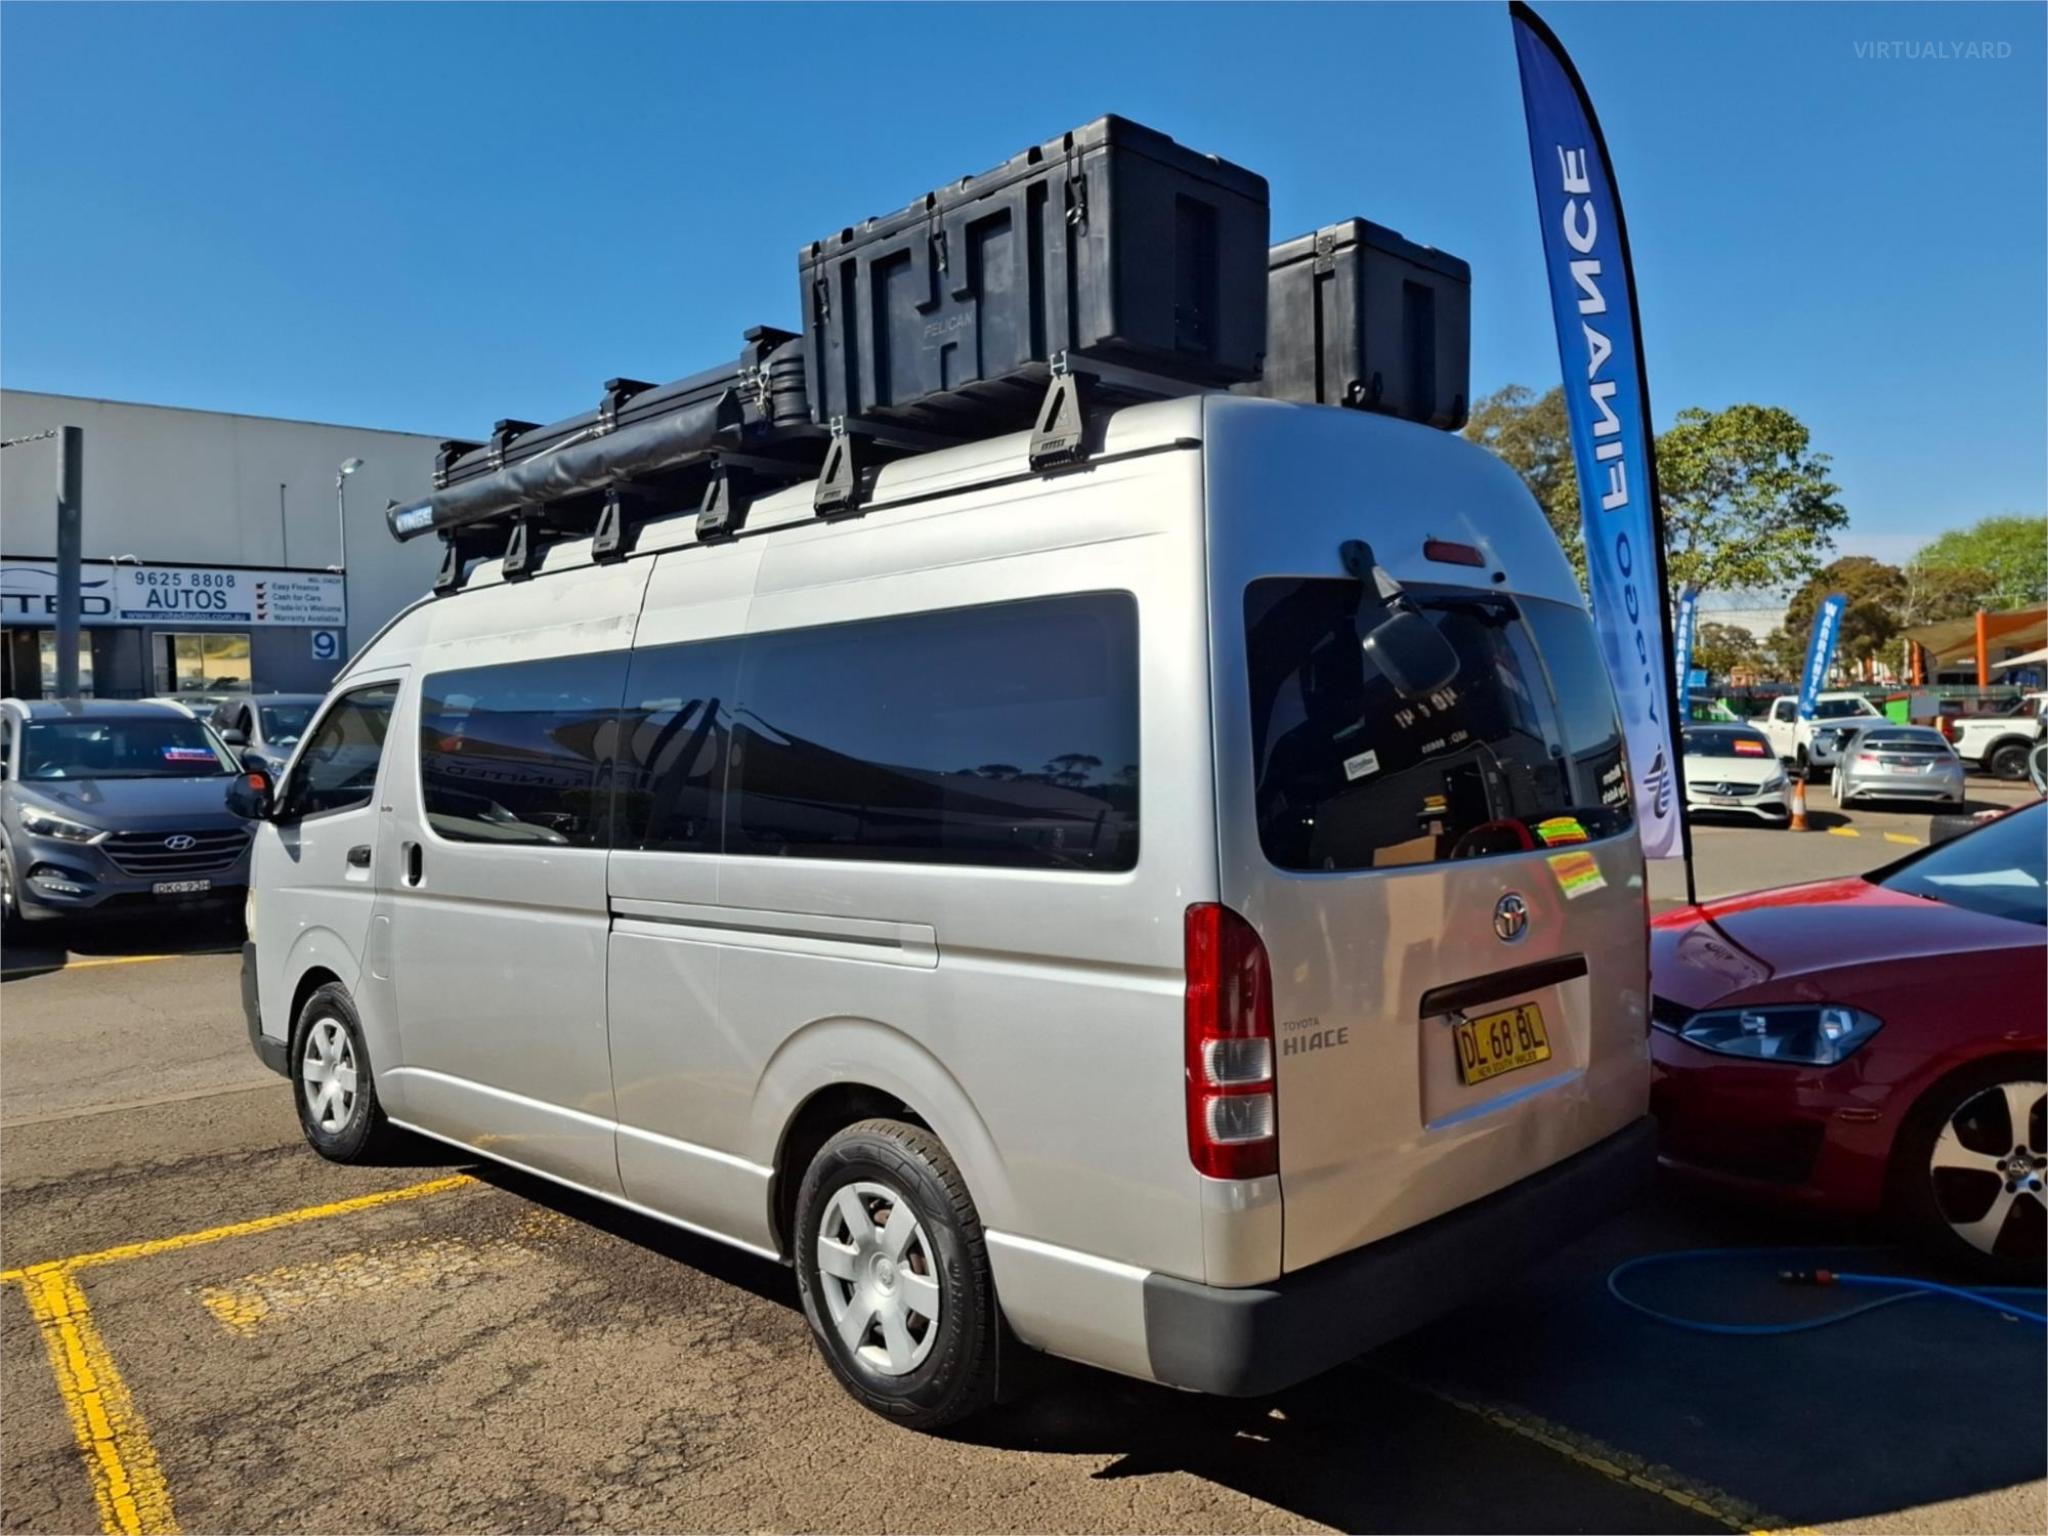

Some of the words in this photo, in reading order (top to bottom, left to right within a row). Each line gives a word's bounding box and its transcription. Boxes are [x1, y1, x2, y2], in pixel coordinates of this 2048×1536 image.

[924, 311, 974, 339] PELICAN
[135, 571, 182, 586] 9625
[191, 573, 236, 588] 8808
[146, 588, 228, 610] AUTOS
[314, 631, 336, 659] 9
[1808, 601, 1838, 700] WARRANTY
[1282, 1016, 1320, 1031] TOYOTA
[1283, 1026, 1349, 1056] HIACE
